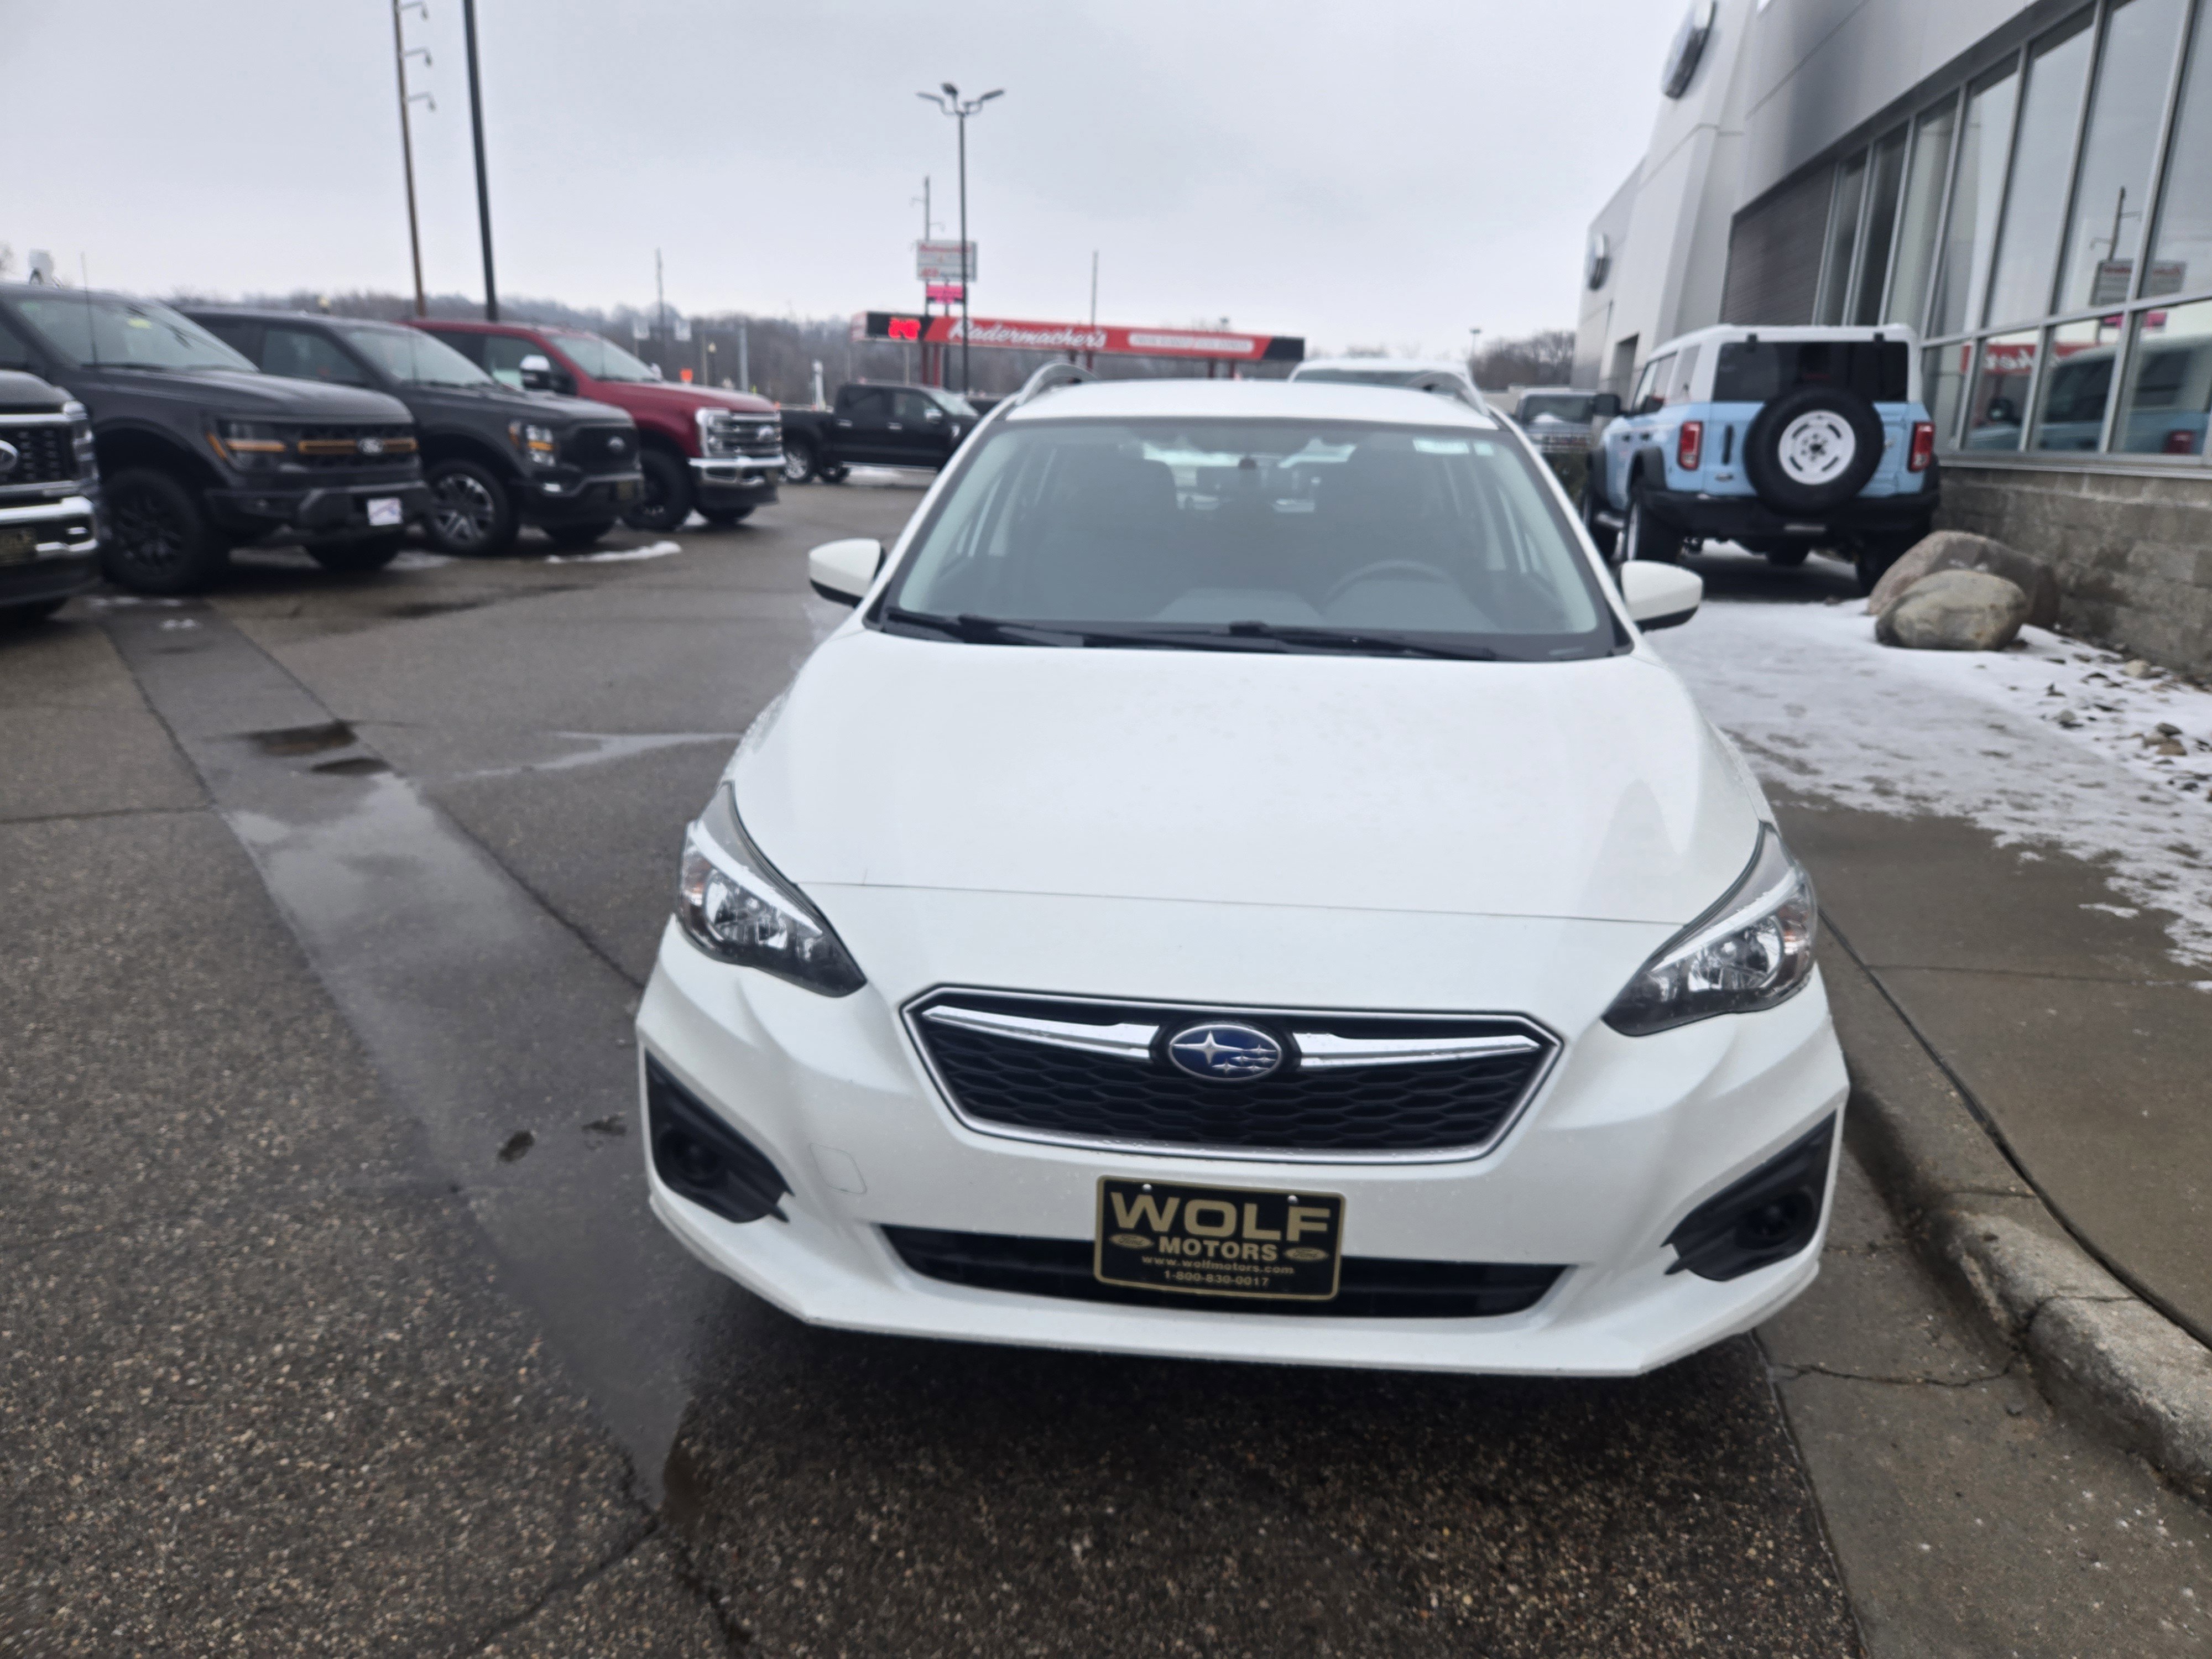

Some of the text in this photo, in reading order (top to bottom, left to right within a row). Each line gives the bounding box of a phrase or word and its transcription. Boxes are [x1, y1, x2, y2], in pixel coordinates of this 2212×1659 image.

[1110, 1192, 1331, 1241] WOLF
[1159, 1236, 1278, 1261] MOTORS
[1142, 1256, 1295, 1274] www.wolfmotors.com
